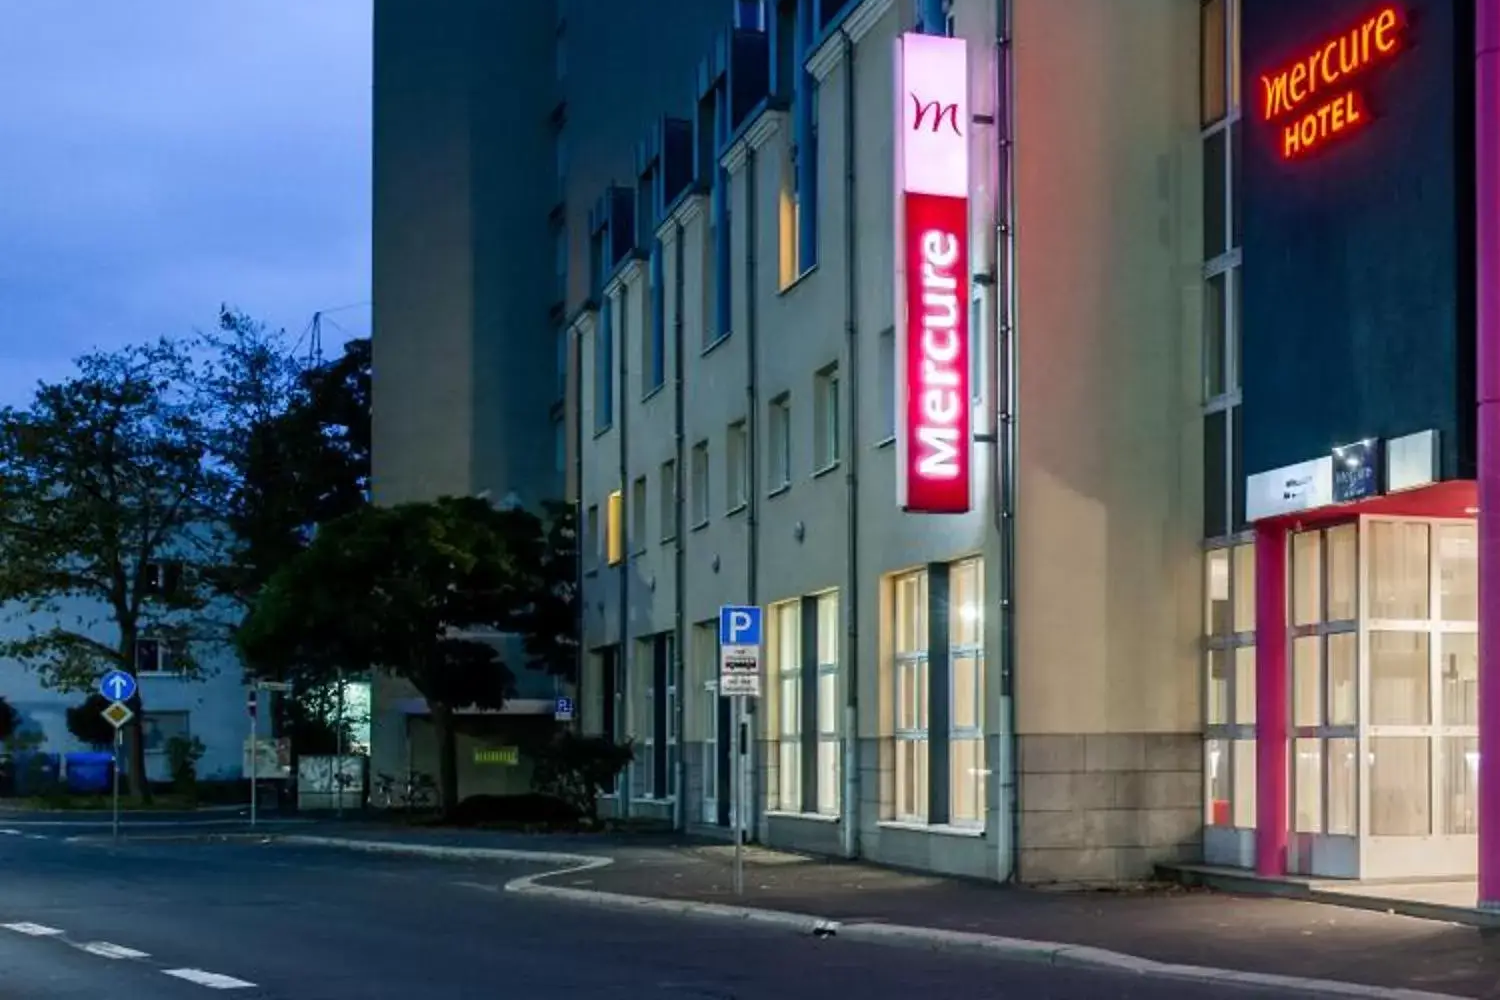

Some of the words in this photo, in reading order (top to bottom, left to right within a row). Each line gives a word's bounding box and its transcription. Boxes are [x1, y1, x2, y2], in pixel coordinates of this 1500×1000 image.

[1284, 91, 1360, 158] HOTEL
[915, 228, 960, 480] Mercure
[730, 611, 752, 642] P
